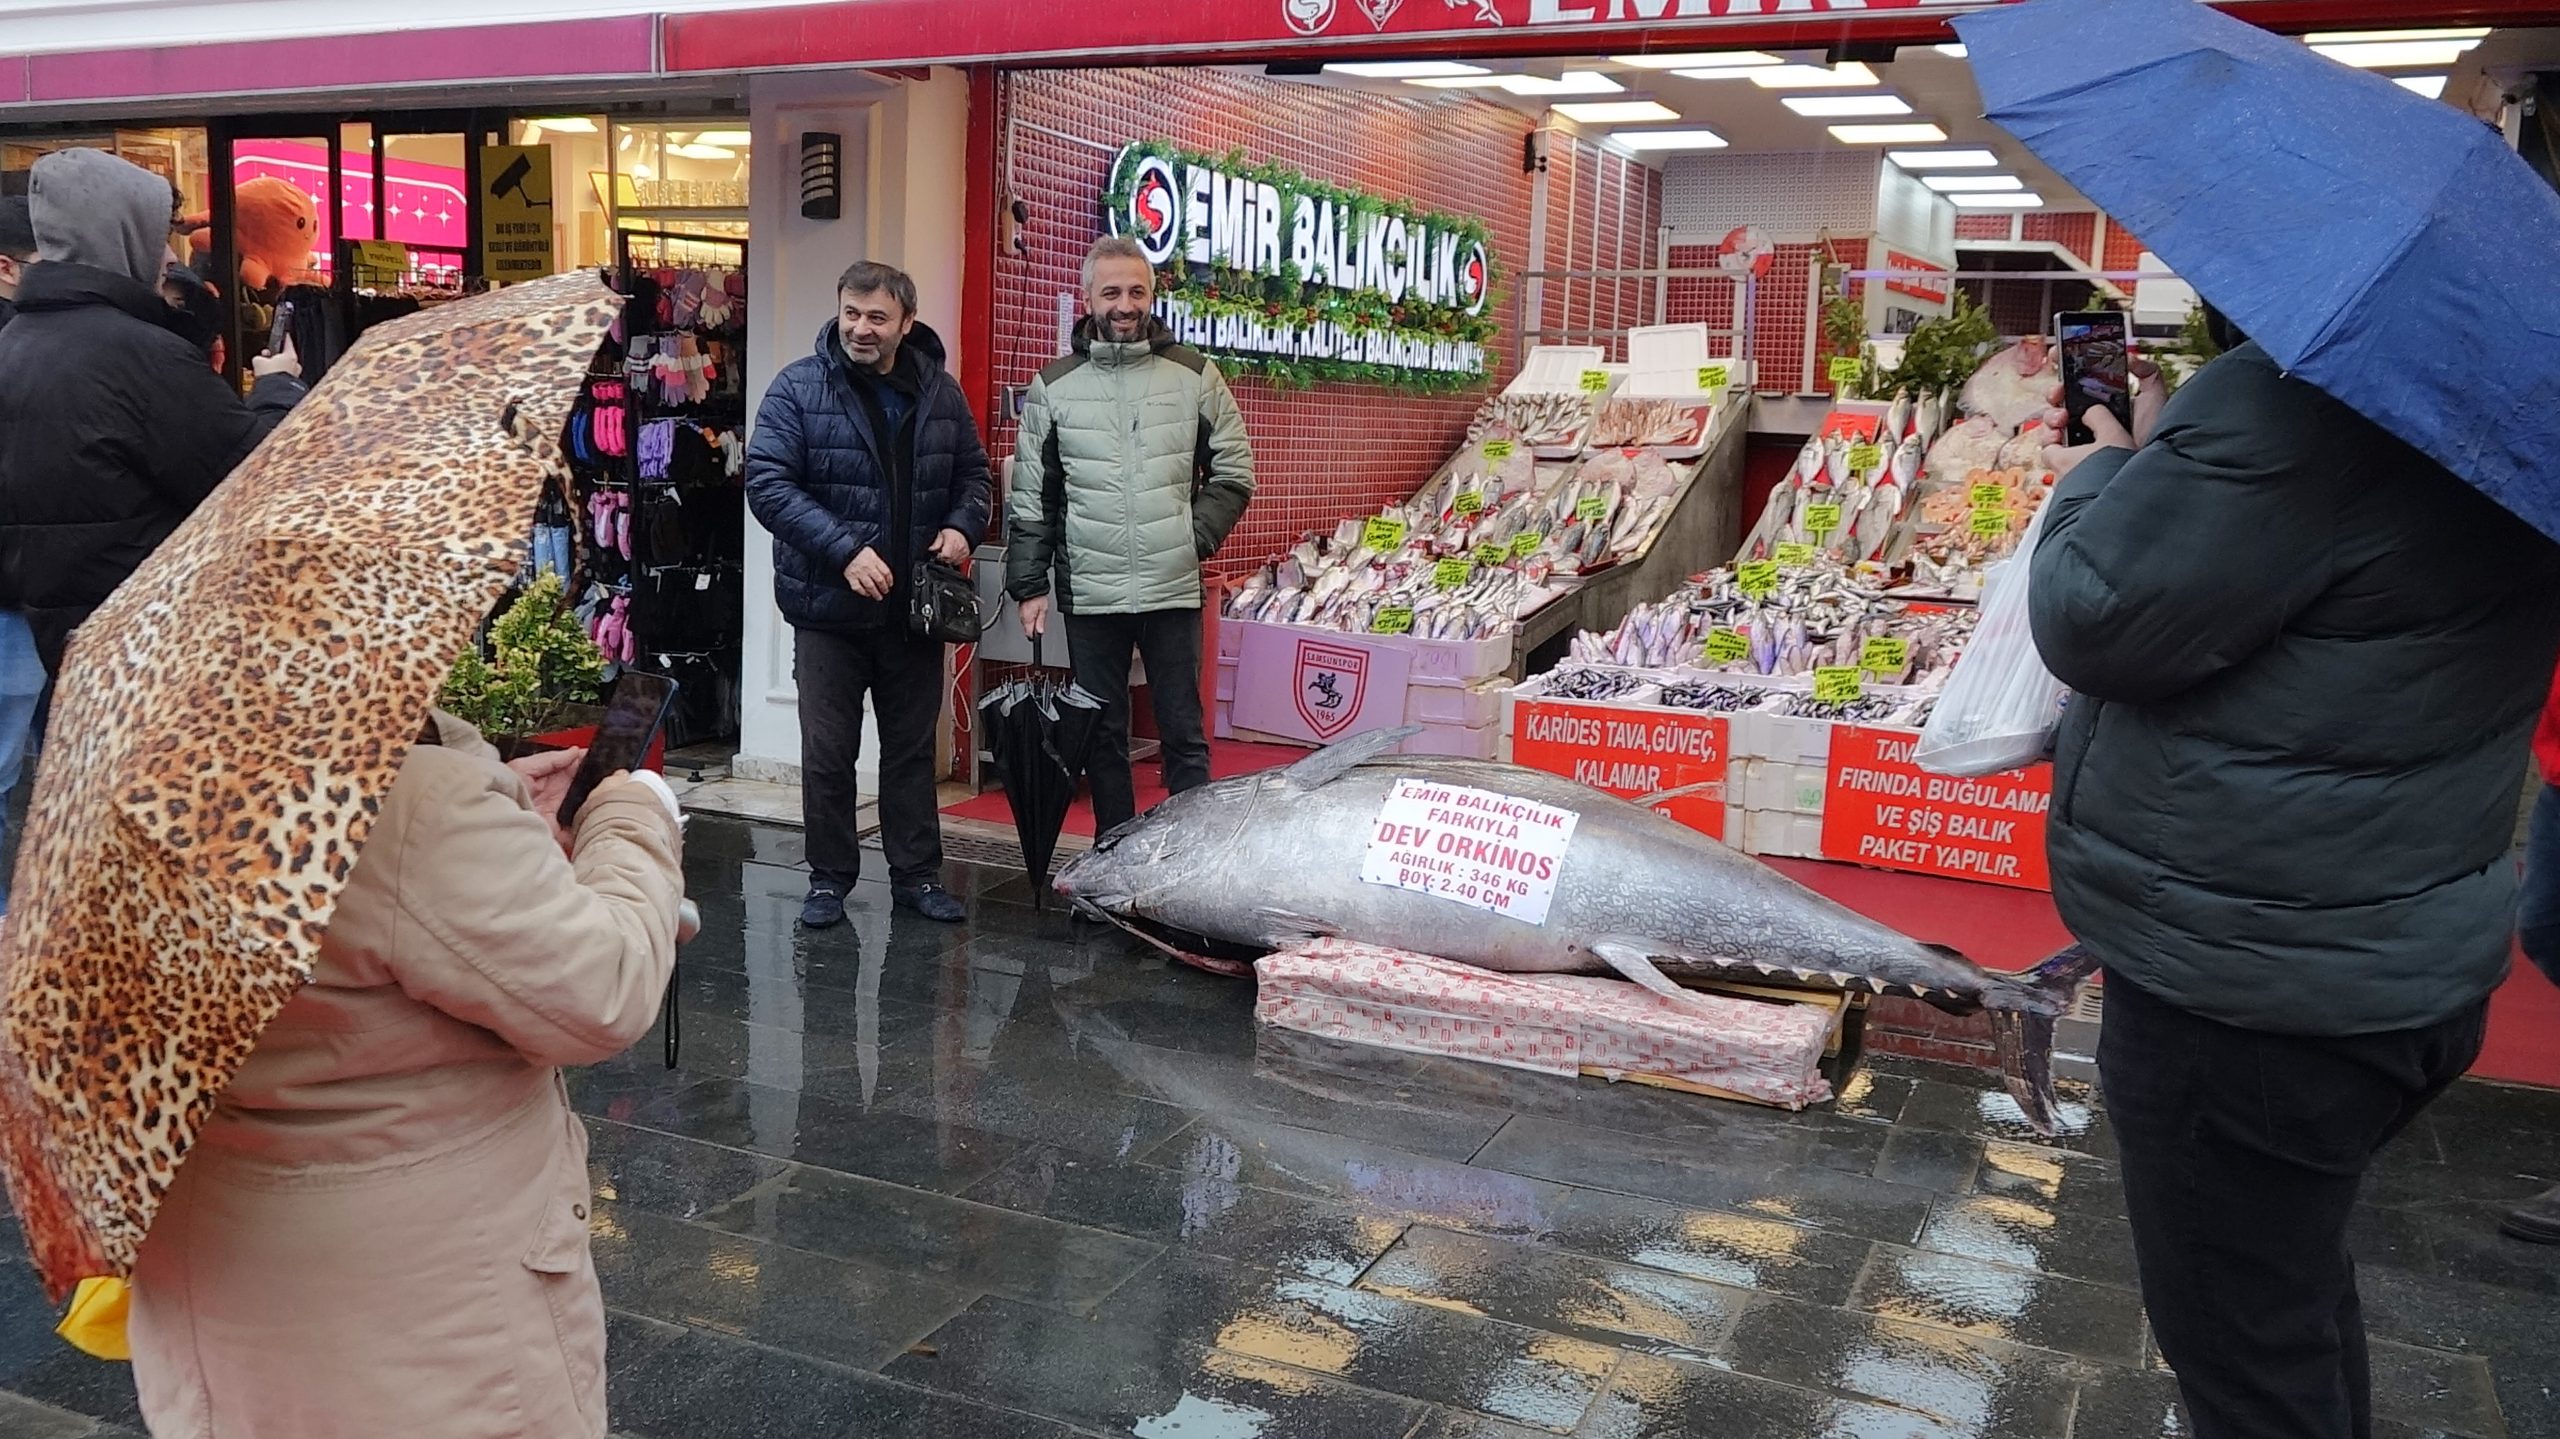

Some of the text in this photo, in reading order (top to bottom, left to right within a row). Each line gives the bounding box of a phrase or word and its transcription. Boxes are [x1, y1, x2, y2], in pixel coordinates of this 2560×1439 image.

[1292, 193, 1459, 308] BALIKÇILIK
[1306, 652, 1358, 669] SAMSUNSPOR
[1316, 709, 1336, 722] 1965
[1526, 710, 1602, 747] KARİDES
[1875, 738, 1917, 765] TAV
[1401, 786, 1564, 828] EMİR BALIKÇILIK
[1838, 766, 1922, 799] FIRINDA
[1926, 778, 2051, 814] BUĞULAMA
[1427, 808, 1519, 839] FARKIYLA
[1875, 803, 2016, 844] VE ŞİŞ BALIK
[1378, 822, 1554, 880] DEV ORKİNOS
[1859, 834, 2021, 878] PAKET YAPILIR.
[1389, 850, 1455, 875] AĞIRLIK
[1469, 868, 1501, 888] 346
[1506, 878, 1529, 896] KG
[1399, 868, 1510, 909] BOY: 2.40 CM
